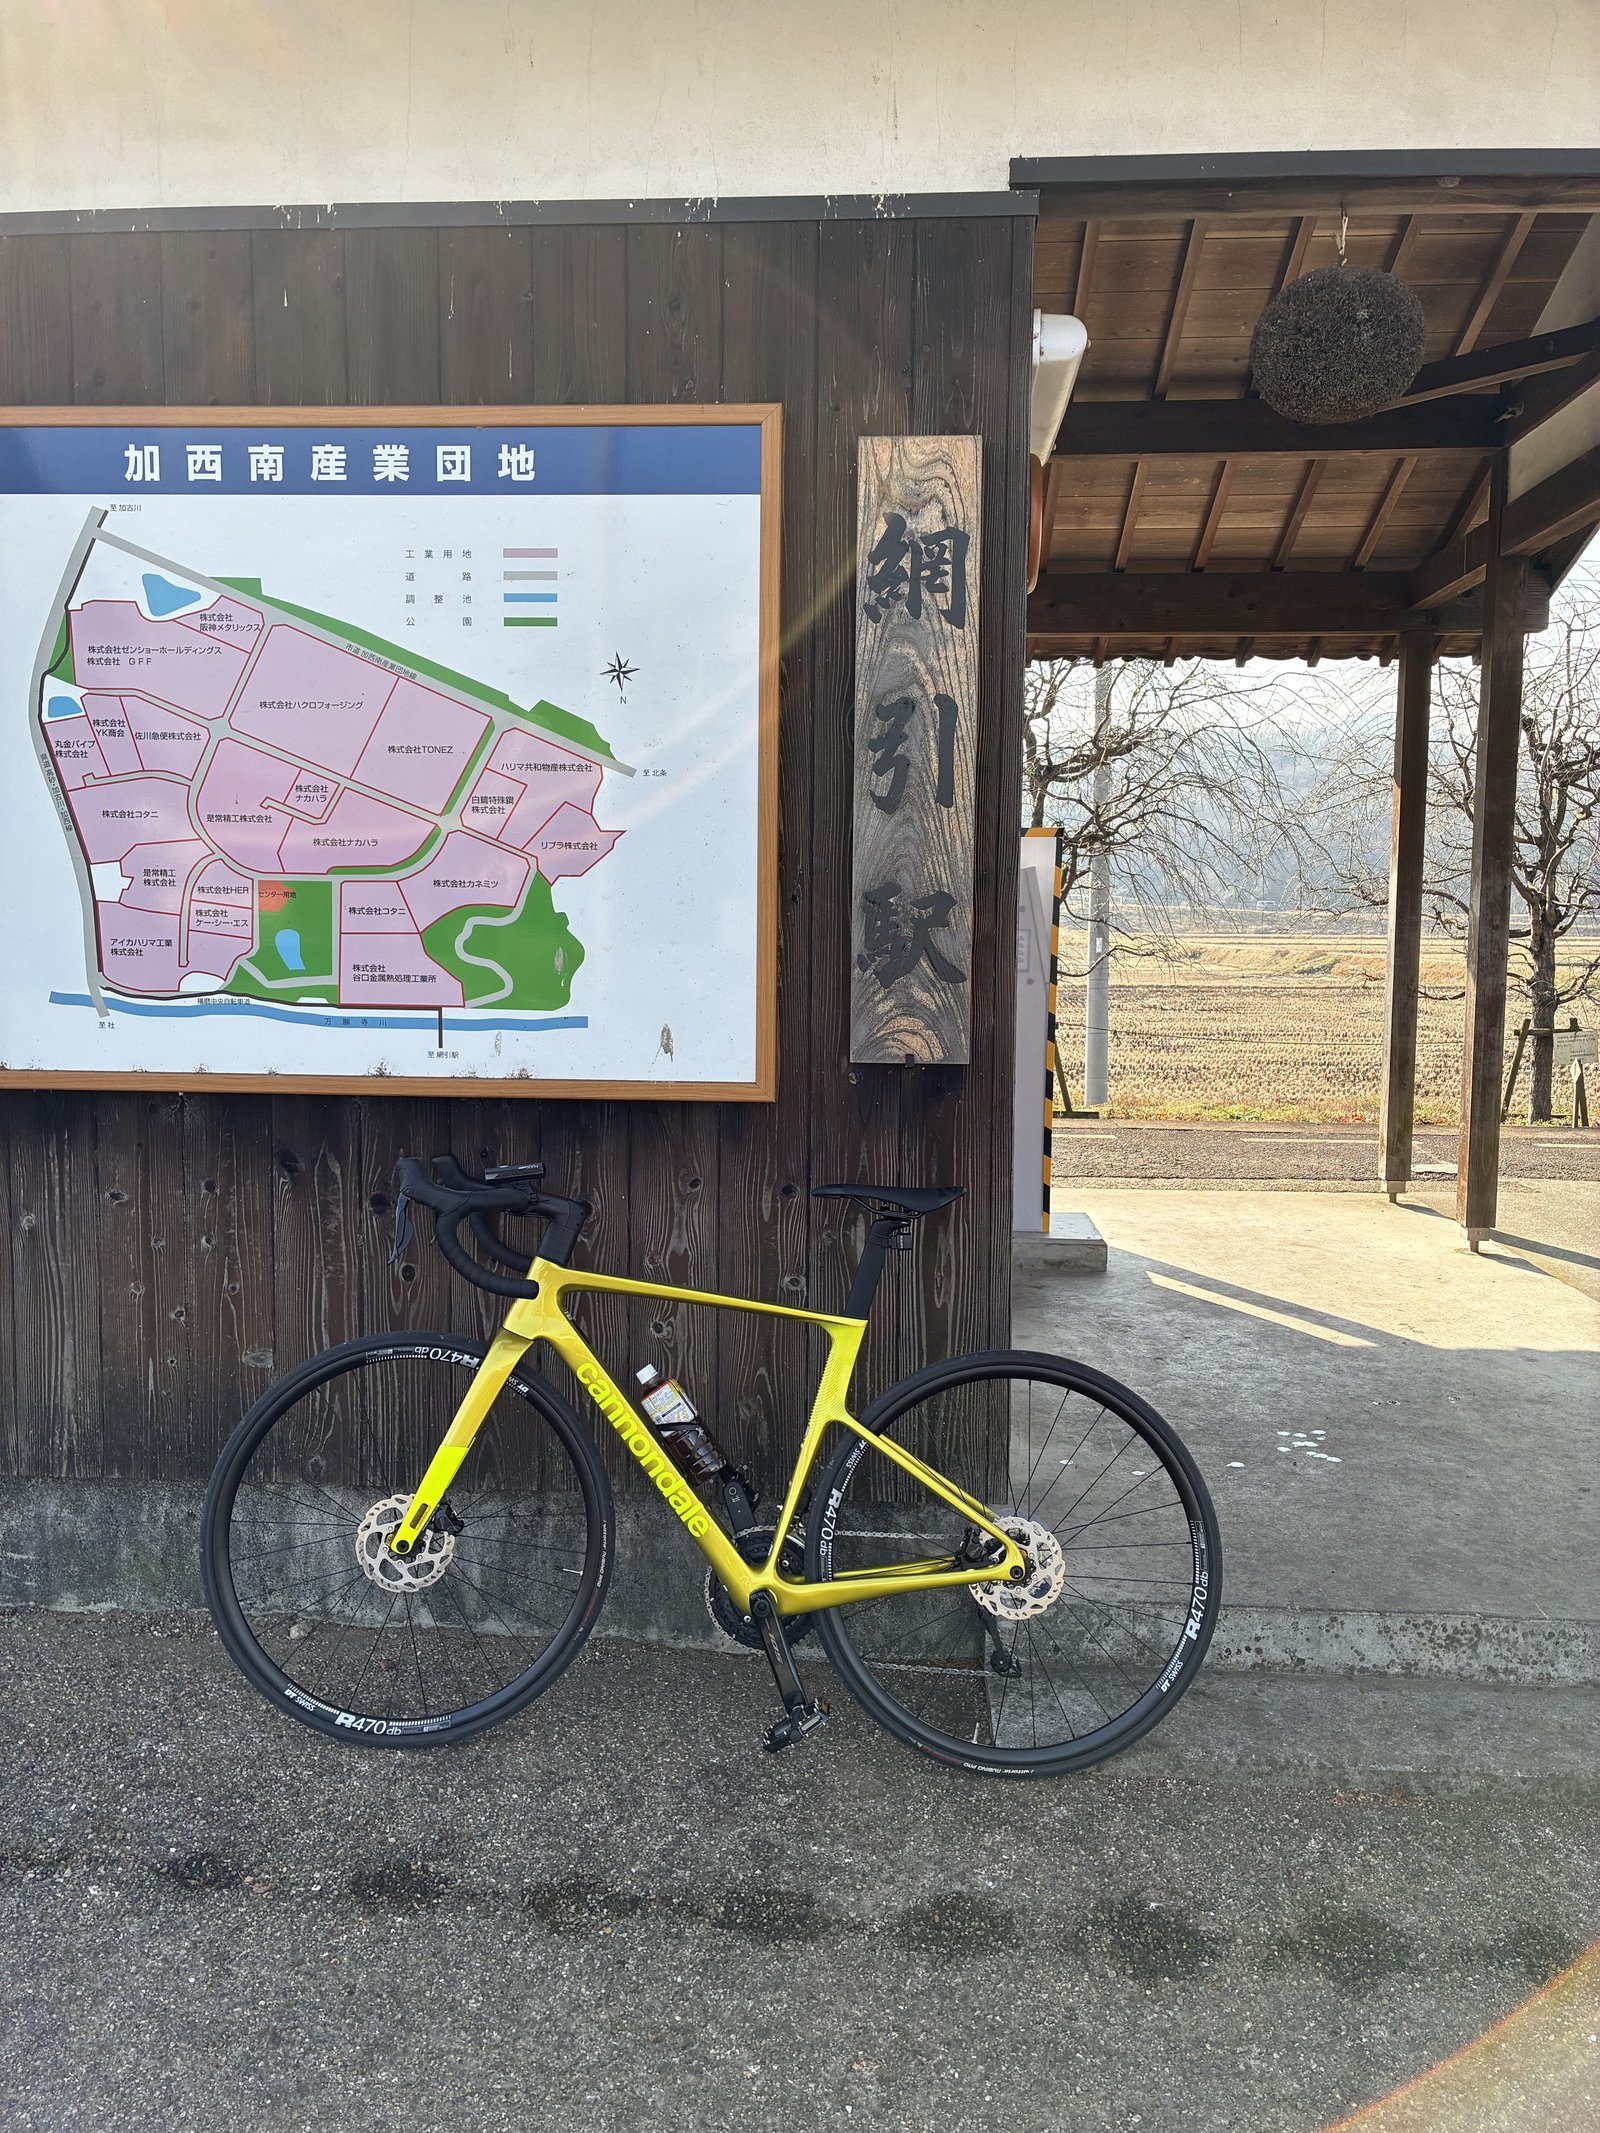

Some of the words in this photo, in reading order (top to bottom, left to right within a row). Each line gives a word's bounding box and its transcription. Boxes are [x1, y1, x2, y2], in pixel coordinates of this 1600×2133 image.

[124, 444, 536, 482] 加西南産業団地
[405, 549, 472, 559] 工業用地
[405, 571, 472, 582] 道路
[405, 594, 472, 604] 調整池
[199, 613, 233, 622] 株式会社
[405, 617, 472, 627] 公園
[200, 623, 261, 632] 阪神メタリックス
[87, 645, 222, 655] 株式会社ゼンショーホールディングス
[87, 657, 120, 666] 株式会社
[620, 696, 627, 704] N
[259, 701, 363, 710] 株式会社ハクロフォージング
[92, 719, 126, 727] 株式会社
[96, 729, 125, 738] YK商会
[134, 732, 202, 741] 佐川急便株式会社
[55, 750, 88, 758] 株式会社
[387, 745, 453, 754] 株式会社TONEZ
[857, 511, 971, 989] 網引駅
[501, 763, 593, 772] ハリマ共和物産株式会社
[295, 785, 328, 793] 株式会社
[295, 795, 327, 803] ナカハラ
[102, 810, 158, 819] 株式会社コタニ
[471, 806, 506, 814] 株式会社
[206, 814, 273, 823] 是常精工株式会社
[312, 838, 378, 847] 株式会社ナカハラ
[143, 869, 176, 877] 是常精工
[143, 879, 176, 887] 株式会社
[433, 879, 499, 889] 株式会社カネミツ
[197, 886, 249, 895] 株式会社HER
[195, 909, 228, 917] 株式会社
[348, 907, 406, 916] 株式会社コタニ
[110, 938, 173, 947] アイカハリマ工業
[110, 948, 144, 956] 株式会社
[352, 964, 386, 972] 株式会社
[352, 974, 437, 983] 谷口金属熱処理工業所
[414, 1346, 430, 1355] db
[430, 1348, 480, 1369] R470
[576, 1362, 709, 1538] cannondale
[820, 1487, 843, 1540] R470
[819, 1540, 827, 1556] db
[1161, 1682, 1171, 1693] DT
[1168, 1660, 1184, 1682] SWISS
[1185, 1586, 1207, 1641] R470
[1201, 1571, 1209, 1587] db
[283, 1688, 297, 1700] DT
[294, 1696, 316, 1712] SWISS
[334, 1712, 386, 1735] R470
[386, 1726, 402, 1736] db
